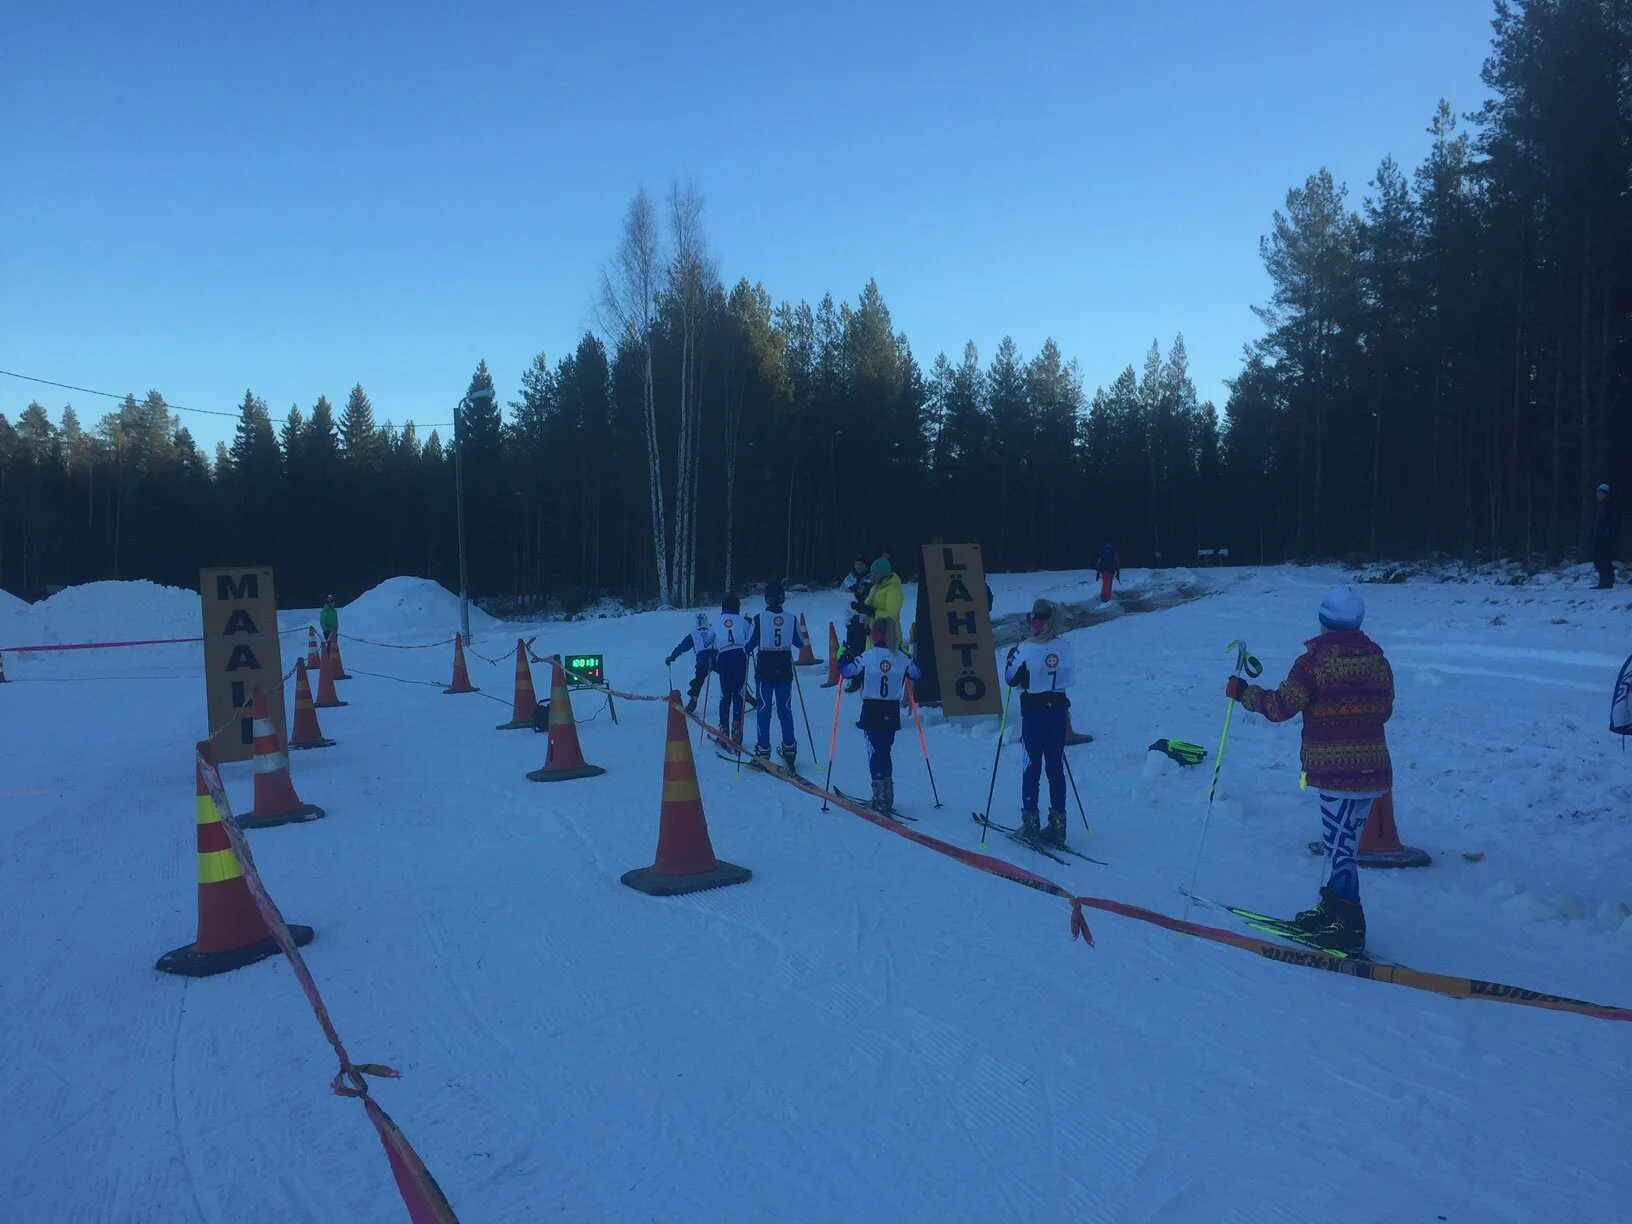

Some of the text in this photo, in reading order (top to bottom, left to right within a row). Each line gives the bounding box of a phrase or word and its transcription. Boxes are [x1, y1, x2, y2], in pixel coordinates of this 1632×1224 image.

[943, 547, 986, 702] LÄHTÖ
[728, 629, 735, 645] 4
[774, 628, 782, 647] 5
[216, 574, 262, 744] MAALI
[880, 675, 888, 698] 6
[1048, 671, 1056, 690] 7
